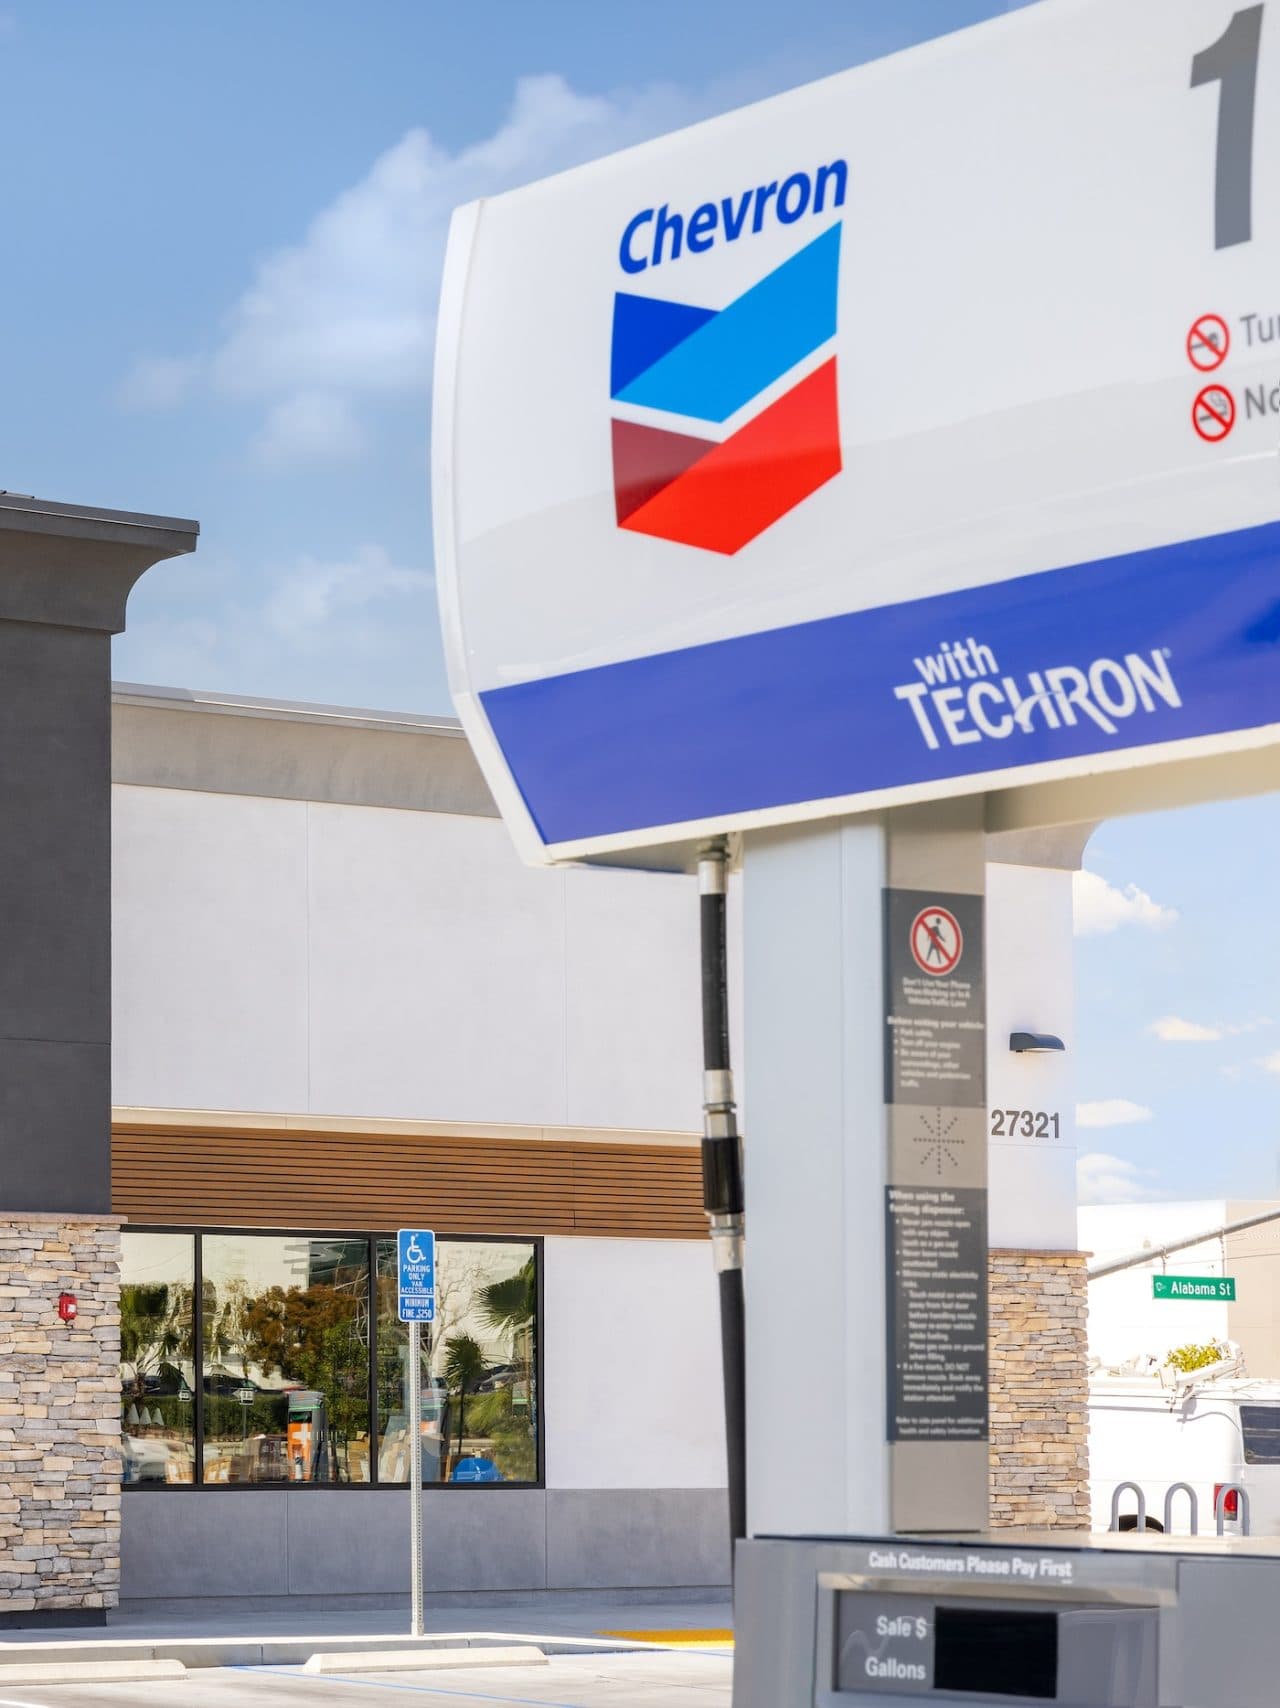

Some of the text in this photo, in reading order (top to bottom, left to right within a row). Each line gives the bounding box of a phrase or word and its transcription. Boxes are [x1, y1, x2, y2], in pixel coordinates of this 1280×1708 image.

[1190, 2, 1264, 251] 1
[619, 158, 849, 275] Chevron
[913, 637, 999, 686] with
[893, 649, 1183, 750] TECHRON
[991, 1109, 1059, 1138] 27321
[1170, 1281, 1231, 1296] Alabama St
[402, 1308, 415, 1318] FINE
[405, 1299, 429, 1307] MINIMUM
[868, 1551, 1072, 1579] Cash Customers Please Pay First
[877, 1615, 927, 1639] Sale $
[865, 1656, 926, 1680] Gallons
